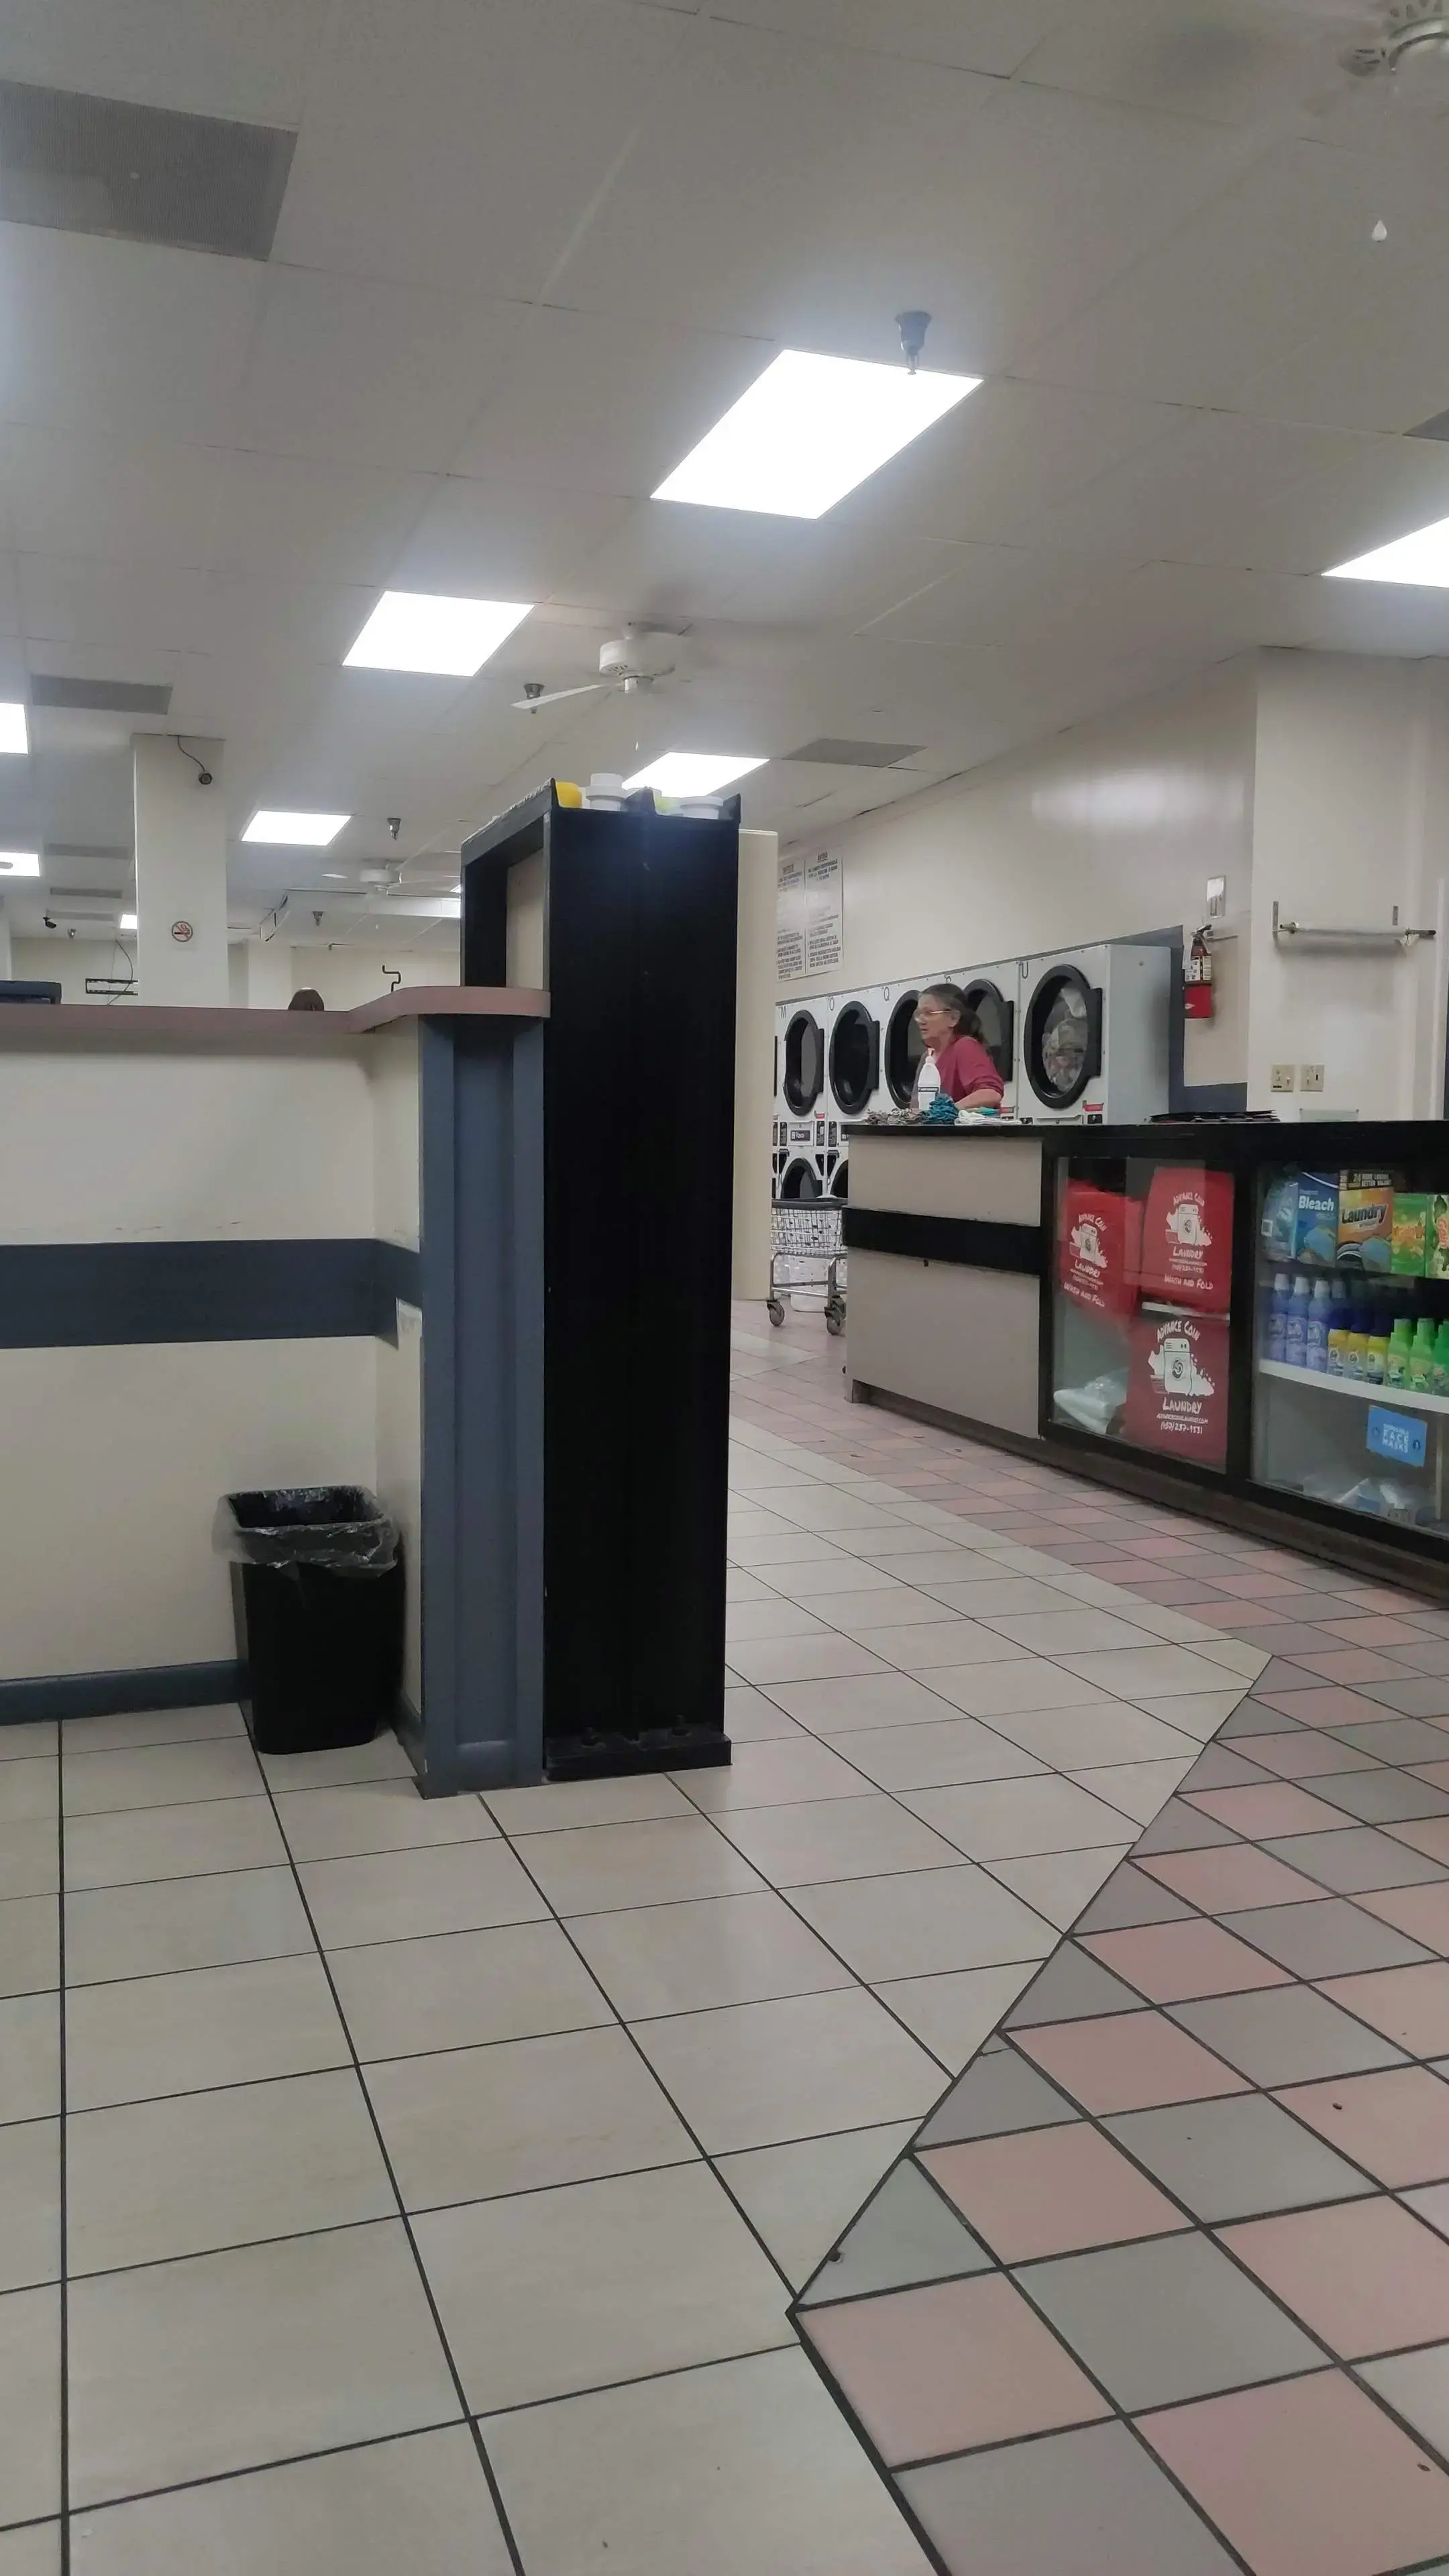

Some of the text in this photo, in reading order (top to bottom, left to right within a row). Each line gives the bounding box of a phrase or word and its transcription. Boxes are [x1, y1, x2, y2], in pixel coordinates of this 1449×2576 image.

[1022, 961, 1028, 979] U
[1298, 1195, 1334, 1212] Bleach
[1342, 1204, 1387, 1224] Laundry
[1173, 1246, 1204, 1260] LAUNDRY
[1196, 1278, 1214, 1290] FOLD
[1157, 1320, 1201, 1342] ADVANCE COIN
[1162, 1396, 1203, 1415] LAUNDRY
[1383, 1429, 1409, 1444] FACE
[1382, 1438, 1409, 1454] MASKS
